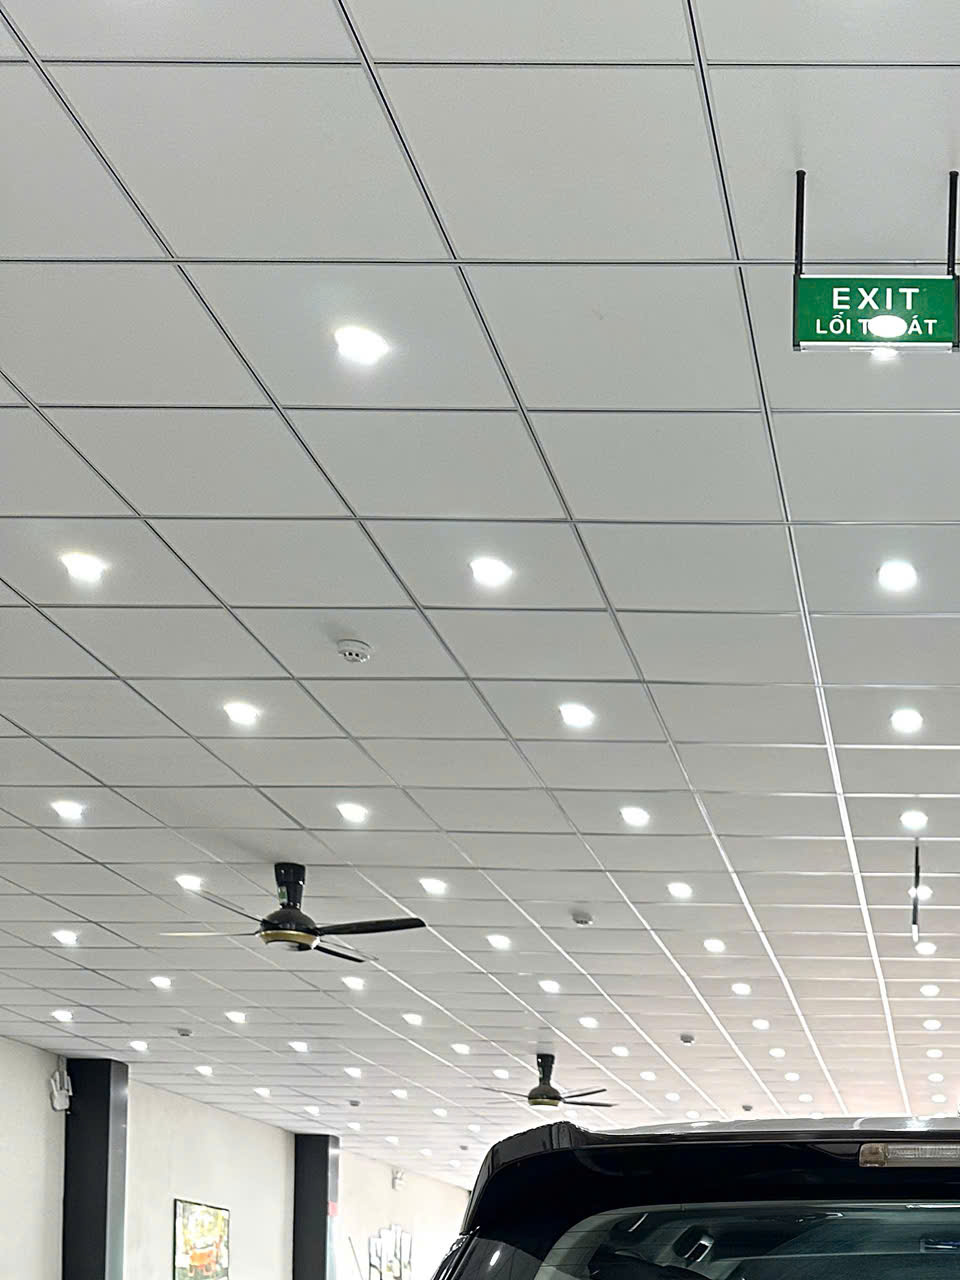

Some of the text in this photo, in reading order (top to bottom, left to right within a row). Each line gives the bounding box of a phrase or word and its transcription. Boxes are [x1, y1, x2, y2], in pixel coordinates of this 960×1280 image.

[832, 287, 920, 310] EXIT
[815, 311, 938, 335] LỐI TÁT
